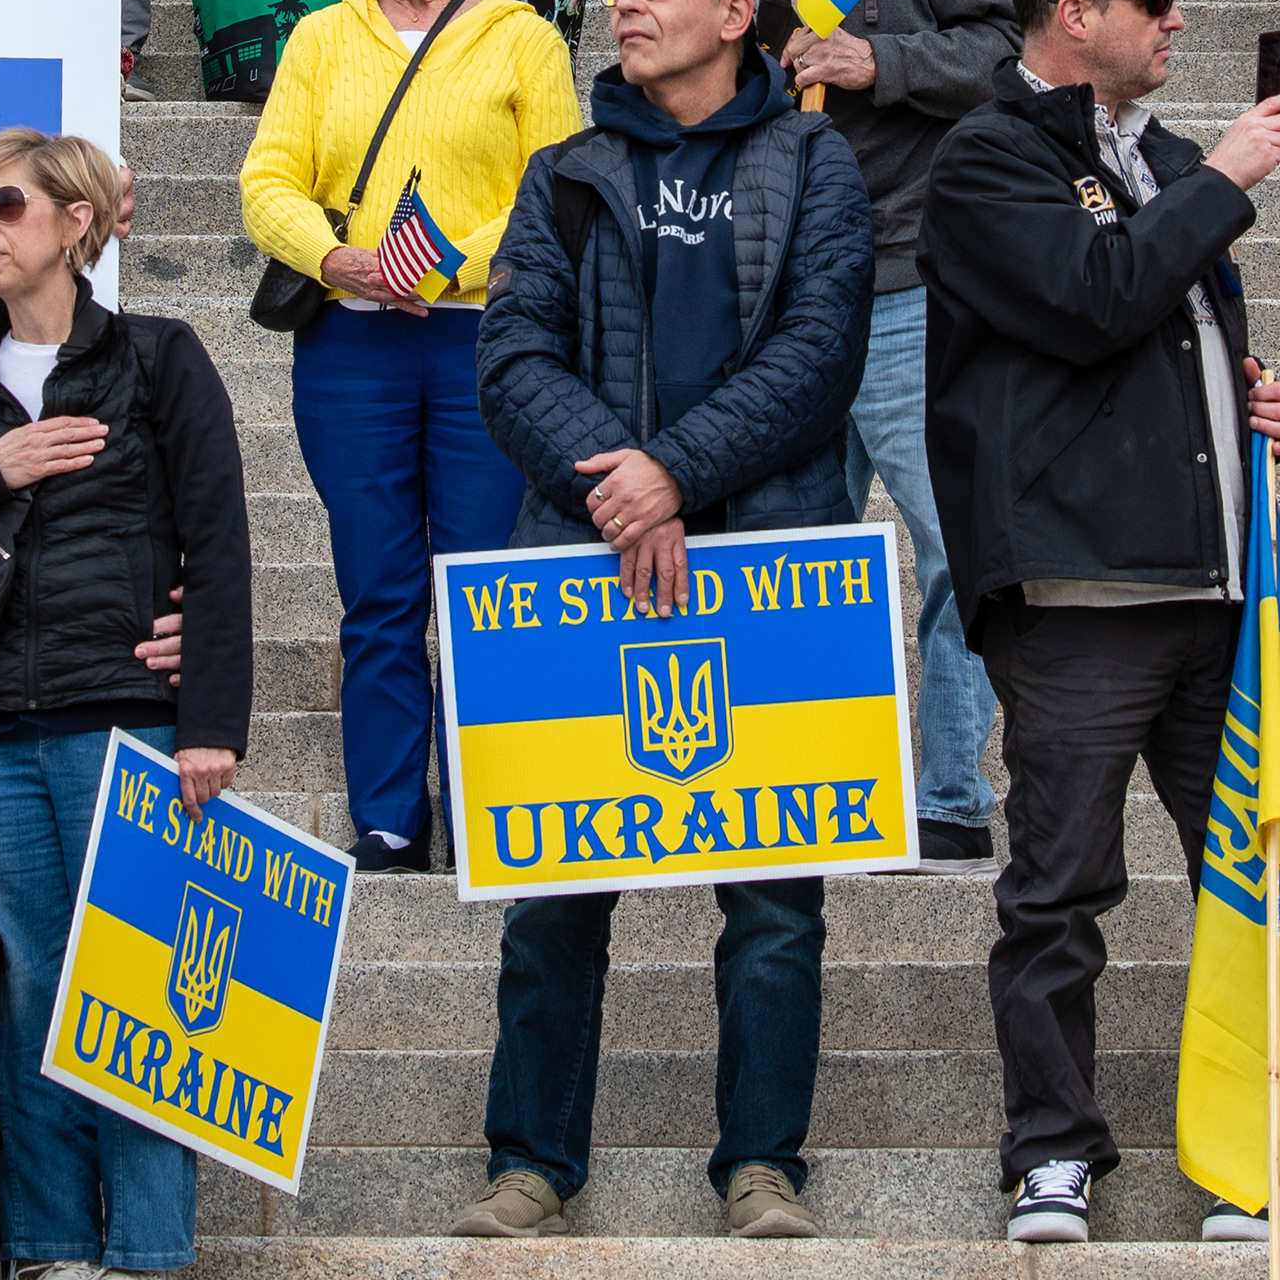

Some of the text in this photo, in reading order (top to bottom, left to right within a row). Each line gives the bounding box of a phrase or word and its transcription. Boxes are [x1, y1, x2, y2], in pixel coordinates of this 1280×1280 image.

[462, 549, 874, 631] WE STD WITH
[117, 768, 161, 834] WE
[262, 847, 337, 928] WITH
[484, 778, 886, 868] UKRAINE
[74, 989, 294, 1158] UKRAINE
